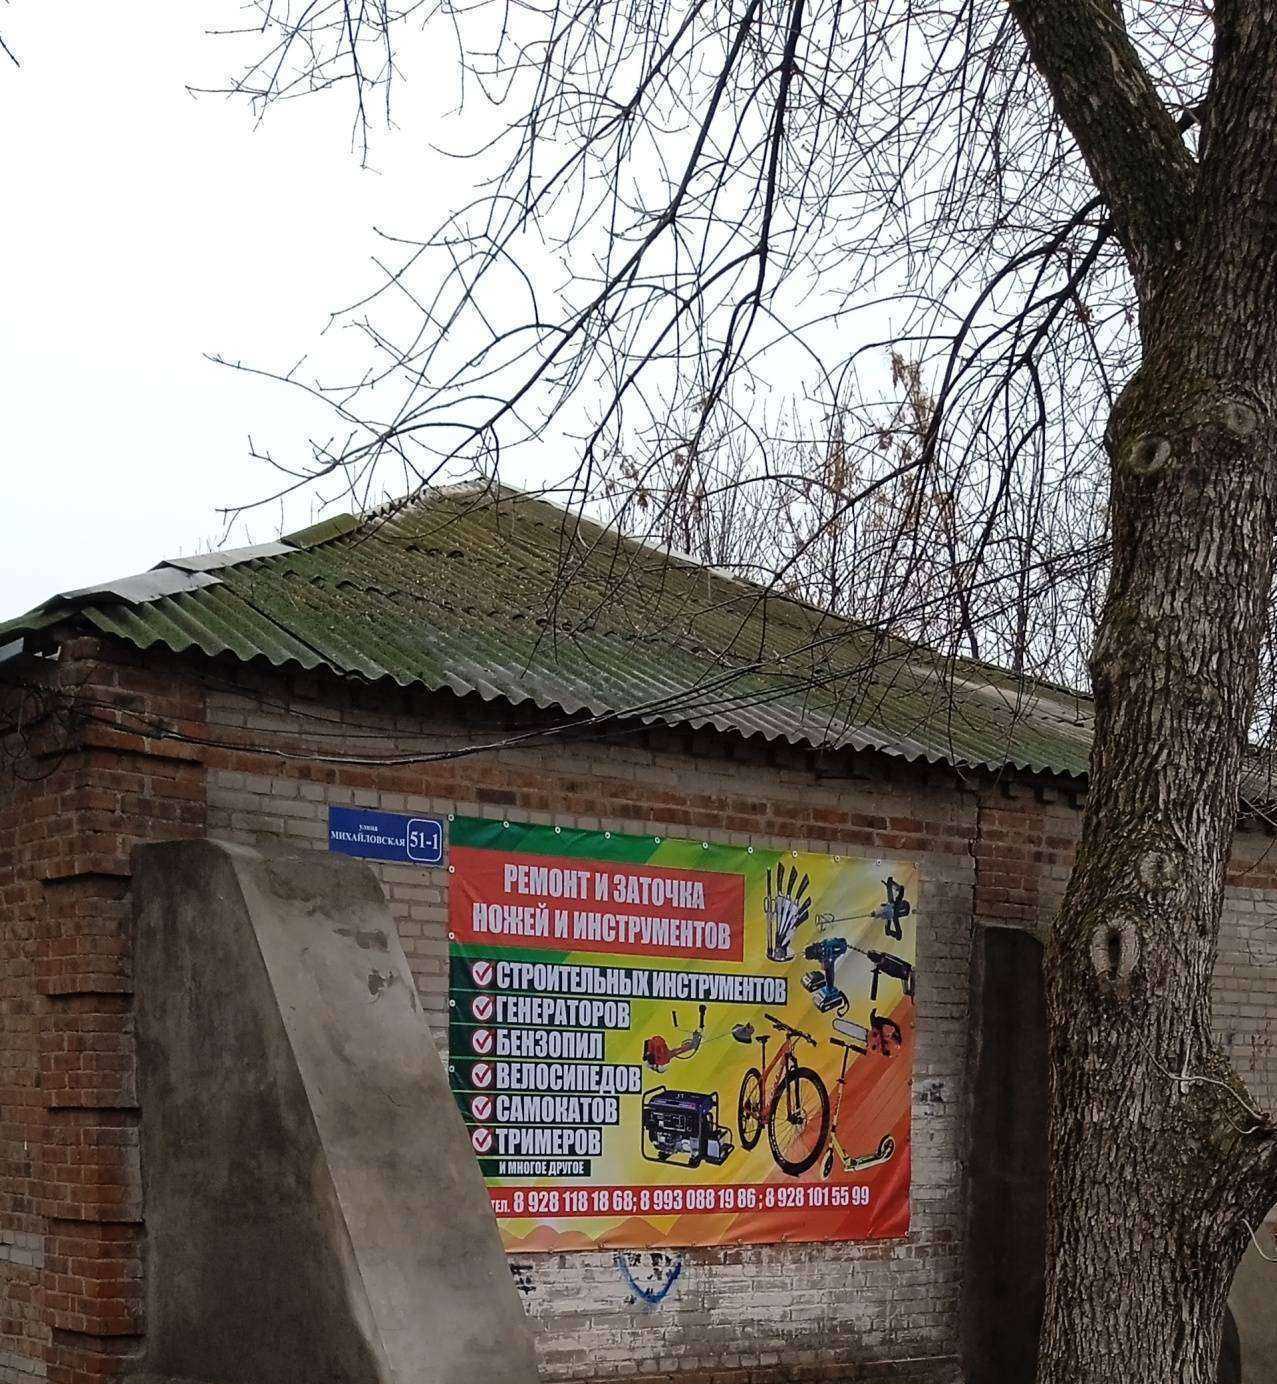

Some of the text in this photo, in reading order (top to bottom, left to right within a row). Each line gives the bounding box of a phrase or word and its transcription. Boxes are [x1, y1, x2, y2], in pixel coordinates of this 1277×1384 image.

[330, 831, 406, 847] МИХАЙЛОВСКАЯ
[359, 824, 378, 832] улица
[410, 831, 438, 850] 51-1
[504, 863, 705, 910] РЕМОНТ И ЗАТОЧКА
[472, 902, 731, 950] НОЖЕЙ И ИНСТРУМЕНТОВ
[496, 961, 787, 1003] СТРОИТЕЛЬНЫХ ИНСТРУМЕНТОВ
[496, 996, 630, 1028] ГЕНЕРАТОРОВ
[496, 1029, 603, 1058] БЕНЗОПИЛ
[496, 1062, 642, 1095] ВЕЛОСИПЕДОВ
[496, 1096, 618, 1124] САМОКАТОВ
[496, 1128, 601, 1155] ТРИМЕРОВ
[499, 1161, 585, 1176] И МНОГОЕ ДРУГОЕ
[513, 1191, 524, 1213] 8
[528, 1191, 560, 1213] 928
[562, 1190, 588, 1212] 118
[591, 1190, 609, 1212] 18
[612, 1190, 637, 1213] 68;
[640, 1190, 650, 1211] 8
[653, 1189, 683, 1211] 993
[686, 1188, 715, 1210] 088
[717, 1188, 735, 1209] 19
[737, 1188, 756, 1209] 86
[777, 1187, 804, 1207] 928
[807, 1186, 828, 1207] 101
[831, 1186, 849, 1206] 55
[851, 1186, 870, 1205] 99
